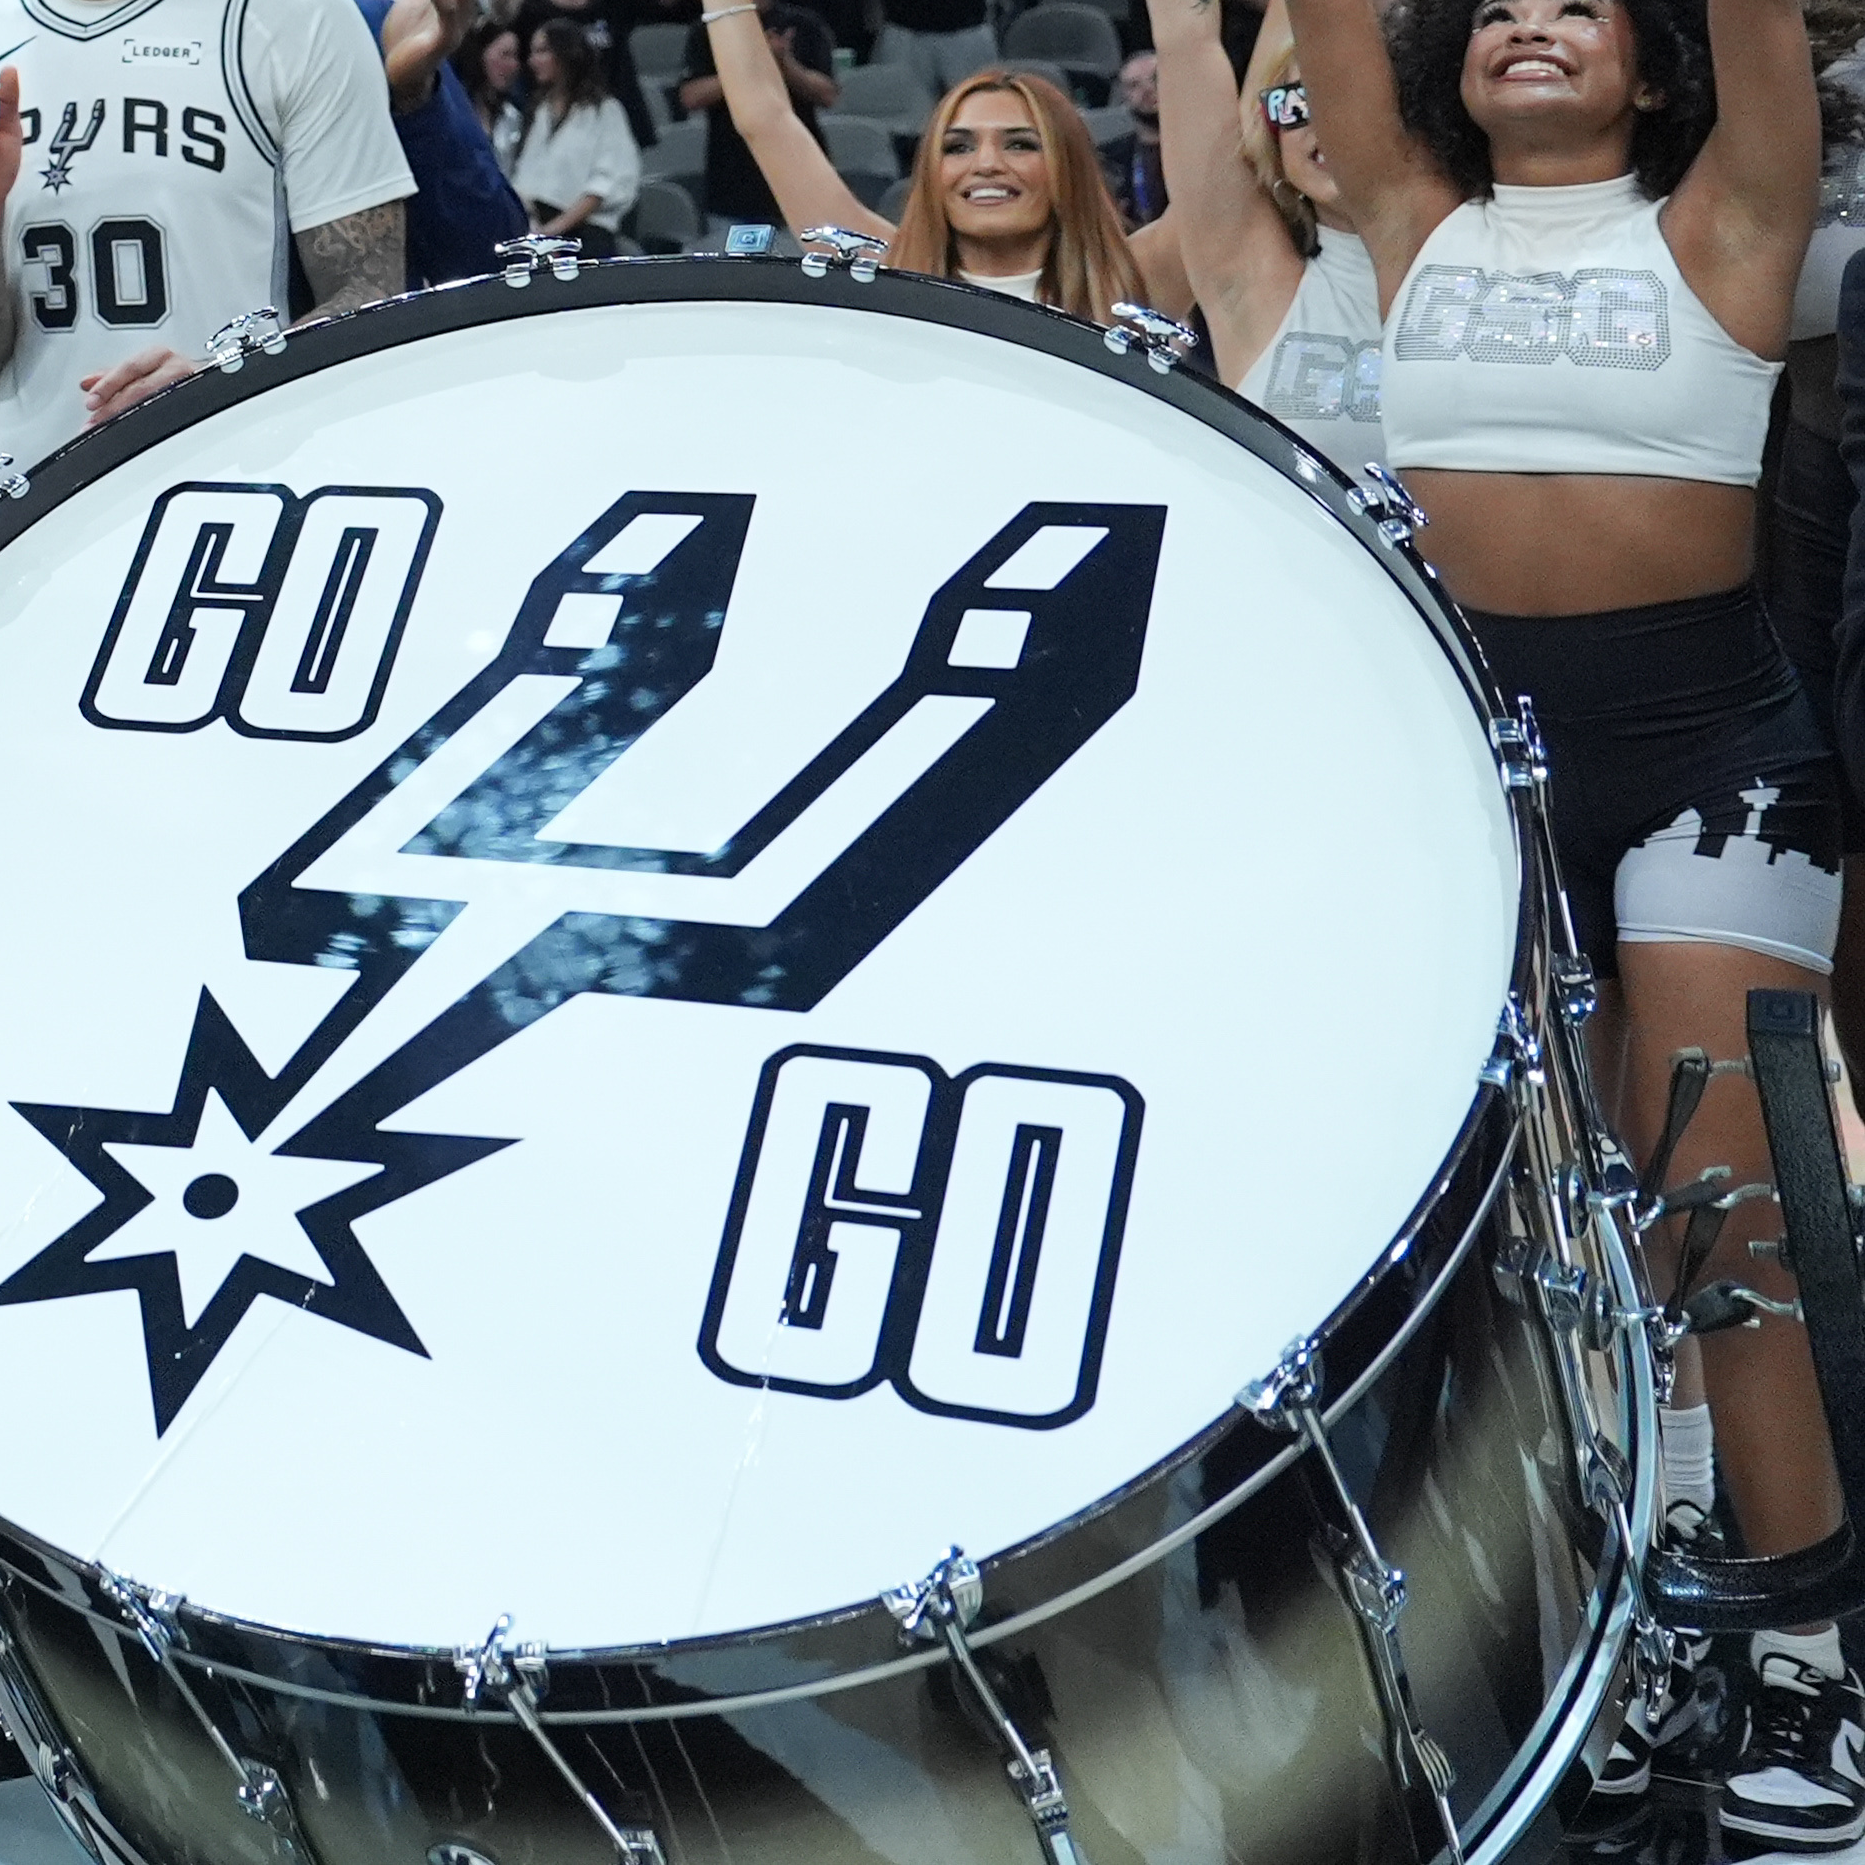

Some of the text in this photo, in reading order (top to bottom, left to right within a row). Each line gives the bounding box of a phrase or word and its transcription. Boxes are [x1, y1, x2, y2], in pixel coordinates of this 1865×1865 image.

[132, 45, 192, 59] LEDGER
[19, 214, 172, 334] 30
[79, 481, 445, 745] GO
[696, 1041, 1146, 1432] GO
